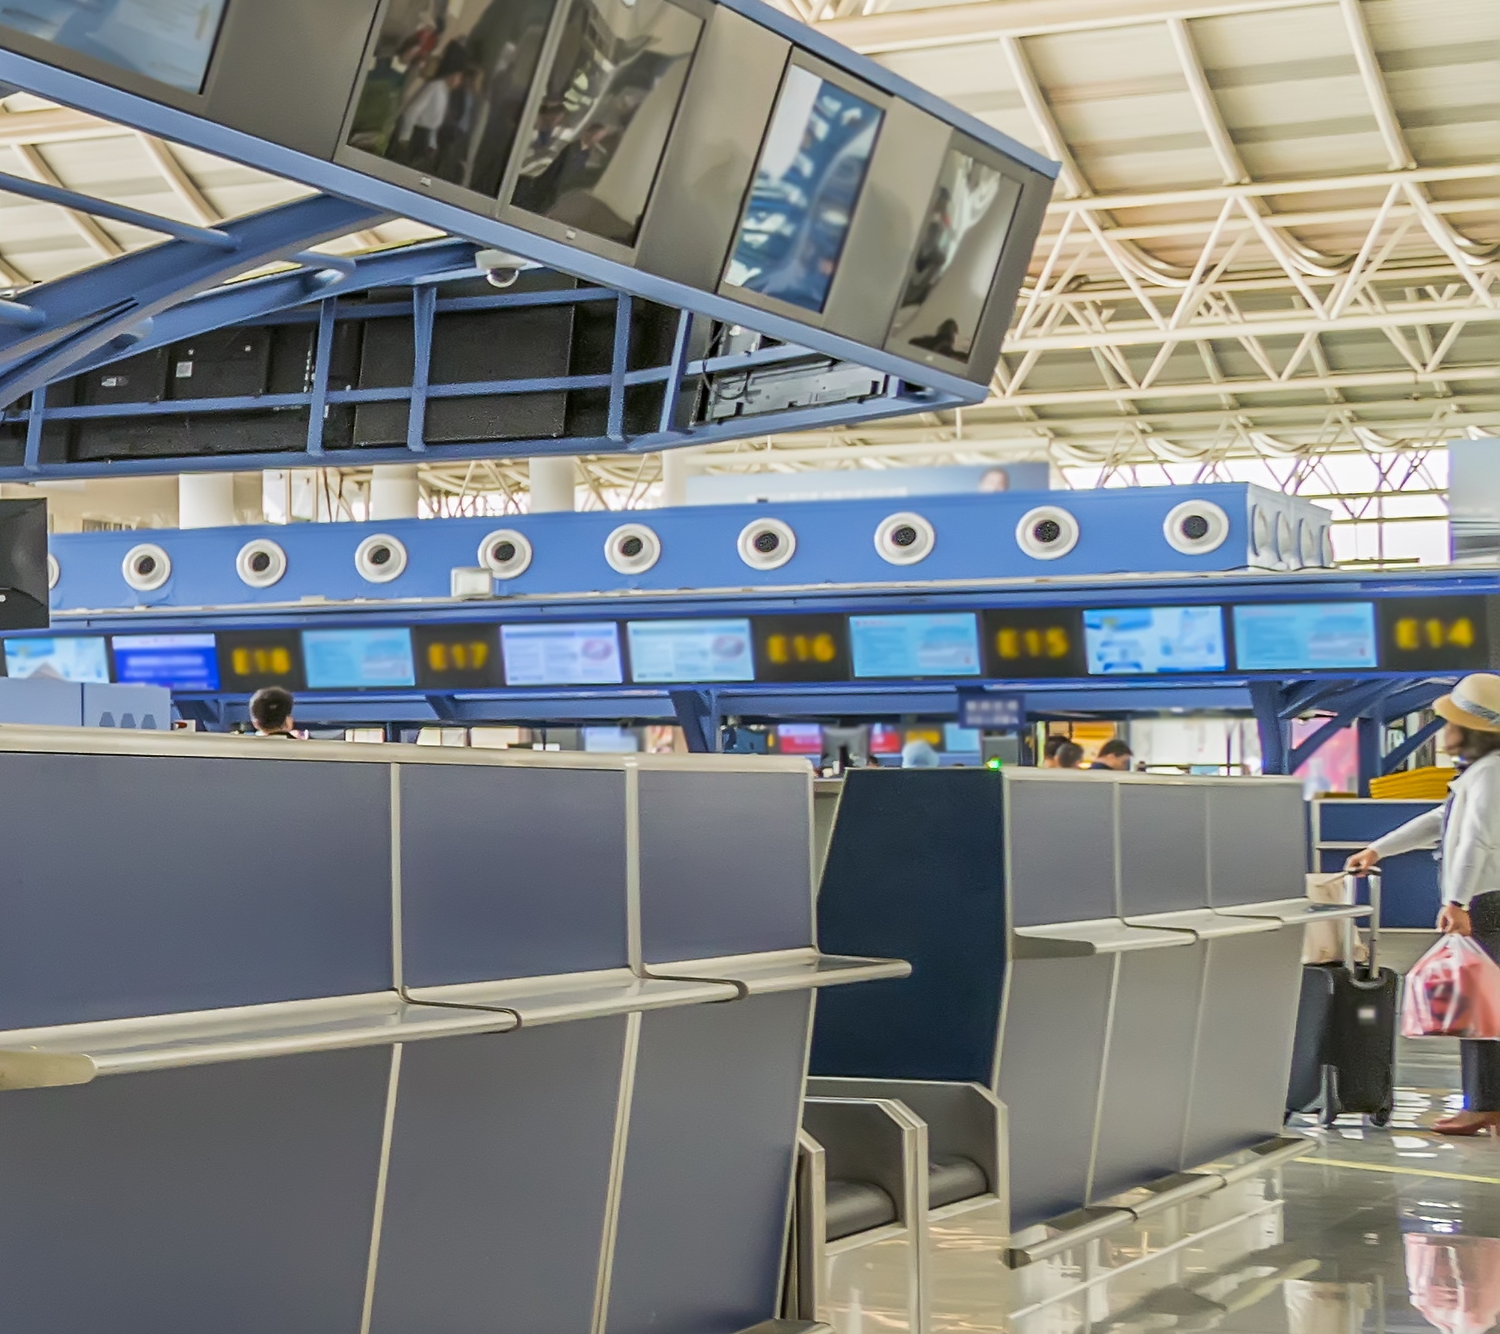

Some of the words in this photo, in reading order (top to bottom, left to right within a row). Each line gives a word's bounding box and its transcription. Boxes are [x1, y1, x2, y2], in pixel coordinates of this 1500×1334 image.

[767, 632, 836, 663] E16
[996, 626, 1069, 658] E15
[1395, 618, 1474, 650] E14
